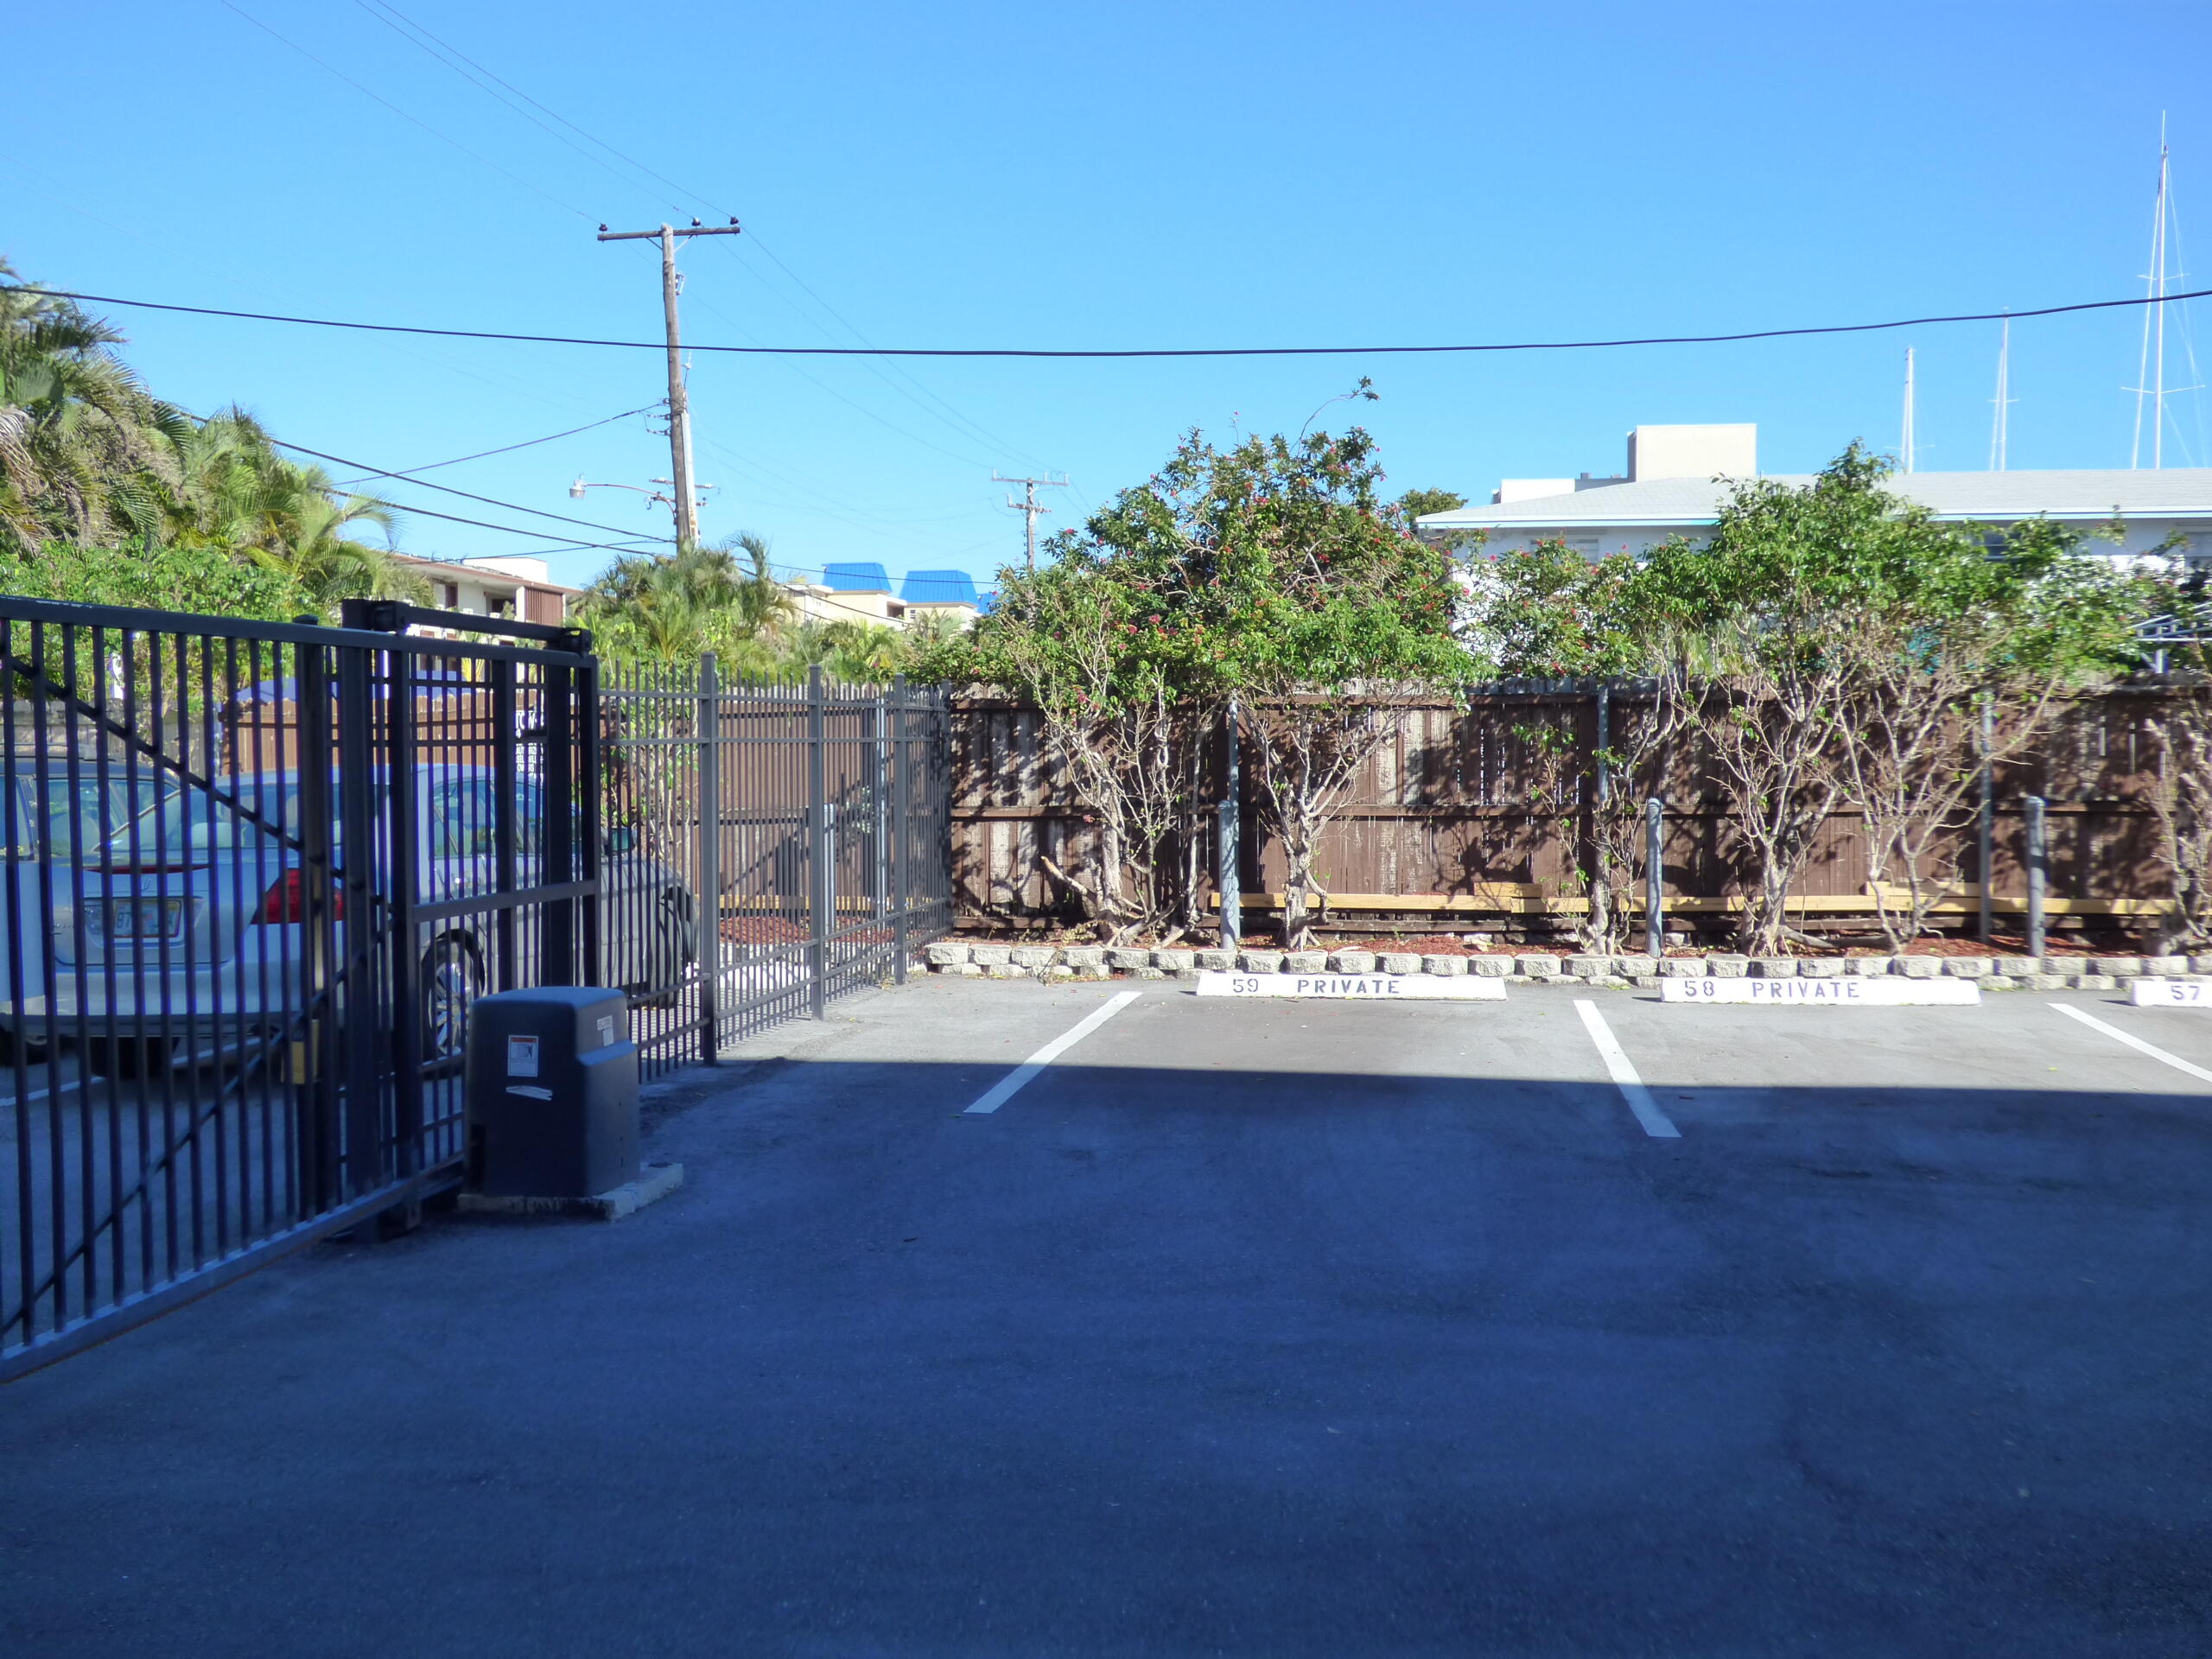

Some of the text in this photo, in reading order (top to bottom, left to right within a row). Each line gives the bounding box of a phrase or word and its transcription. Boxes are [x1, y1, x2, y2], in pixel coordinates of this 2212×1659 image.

[1232, 978, 1401, 994] 59 PRIVATE
[1684, 980, 1860, 998] 58 PRIVATE
[2170, 984, 2200, 1001] 57
